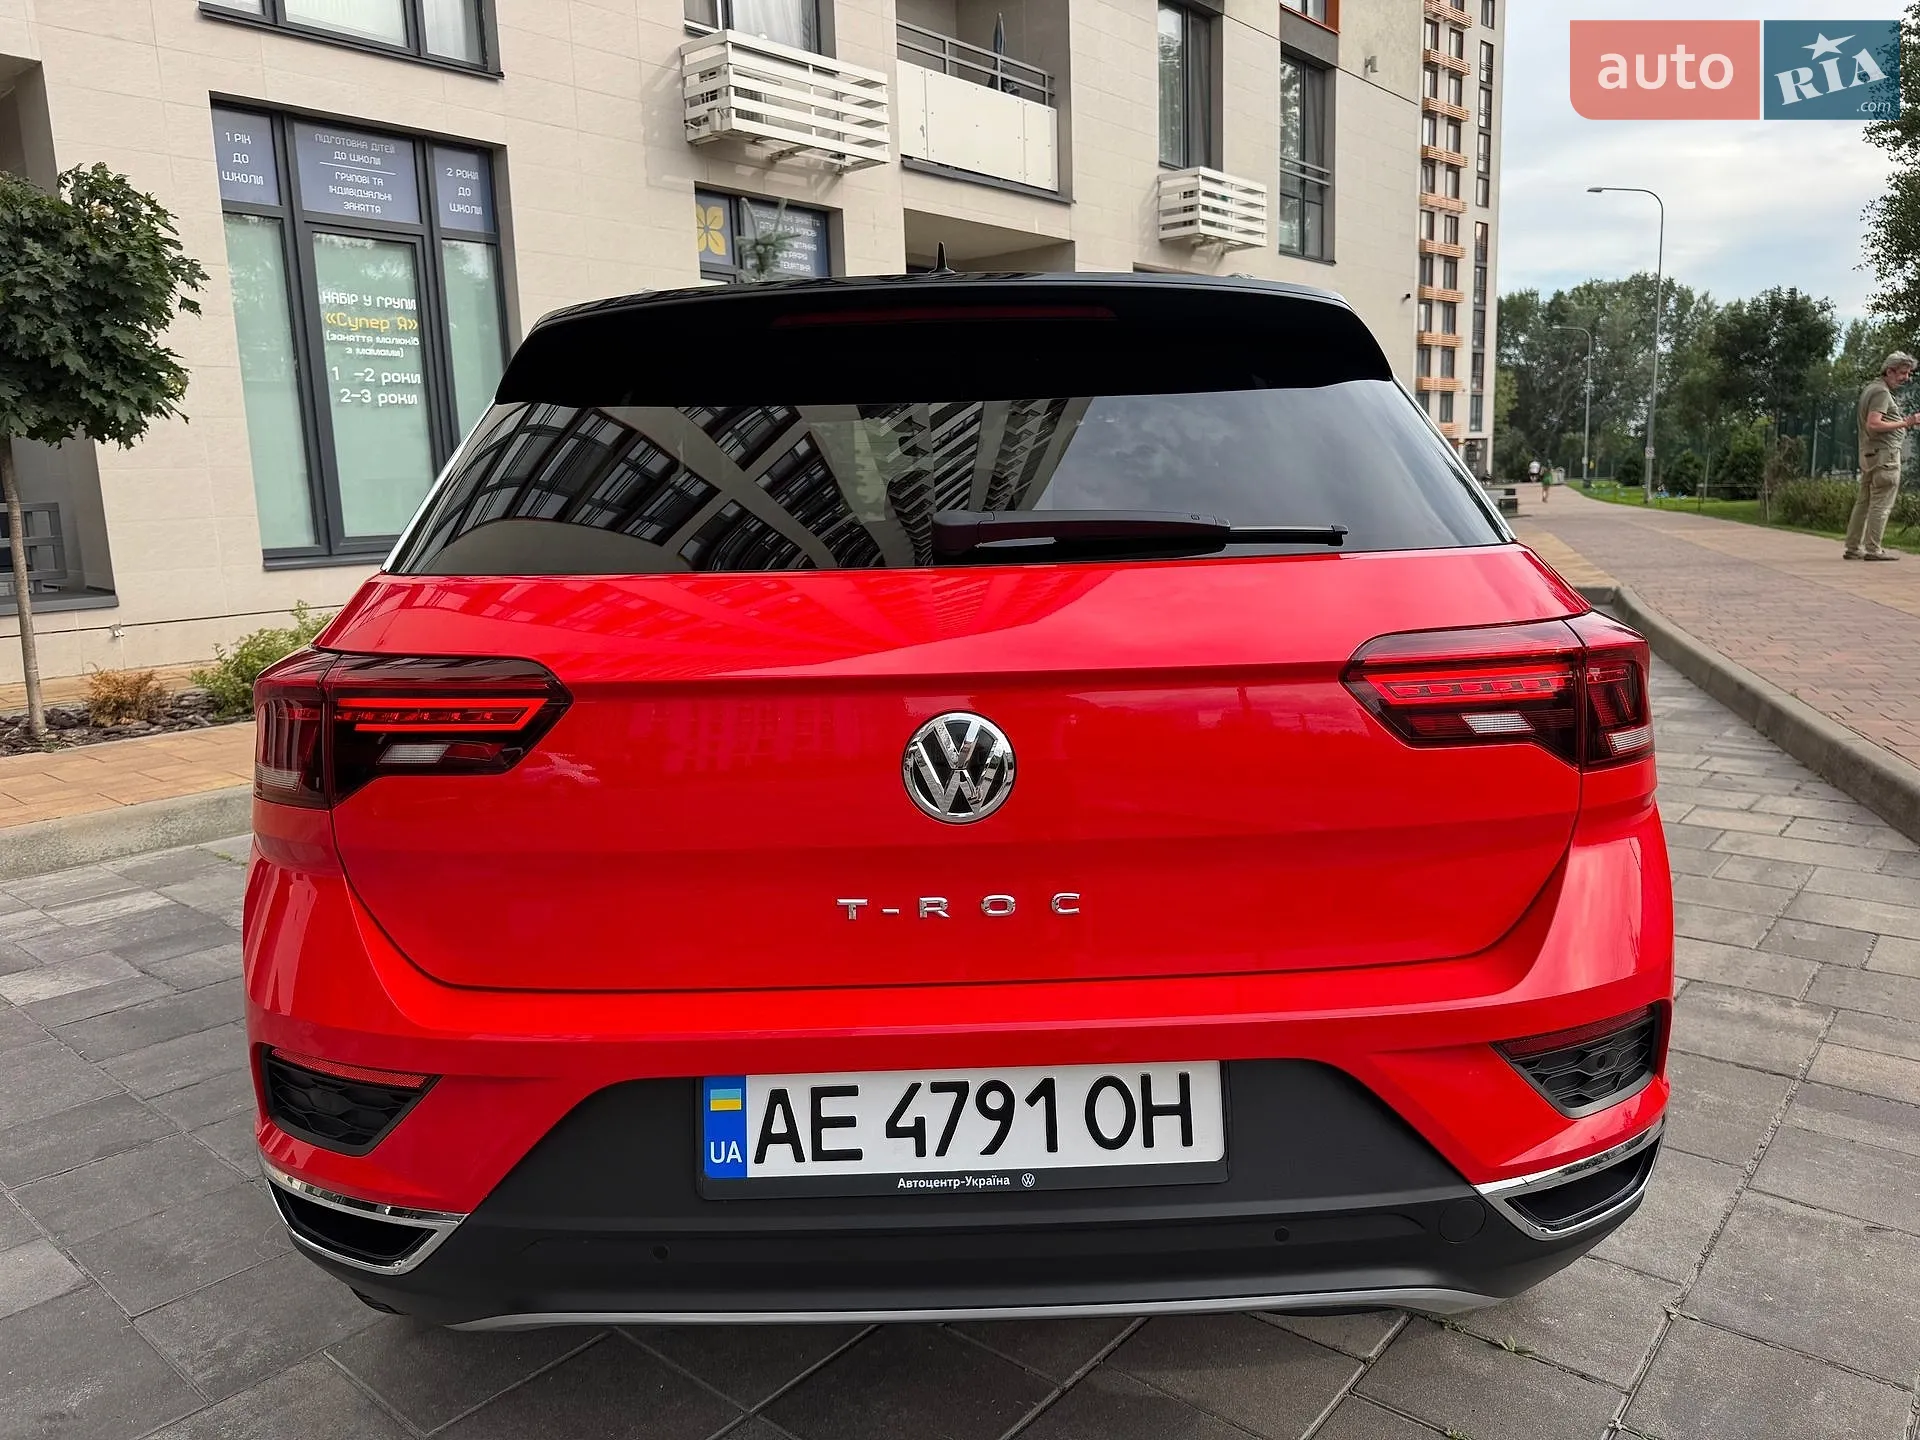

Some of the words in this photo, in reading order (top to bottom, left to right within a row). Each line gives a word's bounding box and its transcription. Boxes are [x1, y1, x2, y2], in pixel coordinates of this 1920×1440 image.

[225, 132, 231, 142] 1
[232, 152, 249, 164] ДО
[333, 151, 347, 161] ДО
[349, 153, 382, 166] ШКОЛИ
[221, 170, 264, 186] ШКОЛИ
[335, 171, 370, 185] ГРУПОВІ
[371, 177, 384, 187] ТА
[446, 167, 453, 177] 2
[457, 186, 471, 197] ДО
[343, 201, 382, 214] ЗАНЯТТЯ
[449, 202, 483, 216] ШКОЛИ
[322, 291, 358, 306] НАБІР
[363, 295, 372, 307] У
[376, 296, 417, 311] ГРУПИ
[753, 1084, 864, 1165] AE
[885, 1076, 1059, 1158] 4791
[1084, 1071, 1194, 1150] OH
[709, 1140, 743, 1165] UA
[897, 1175, 1011, 1189] Автоцентр-Україна
